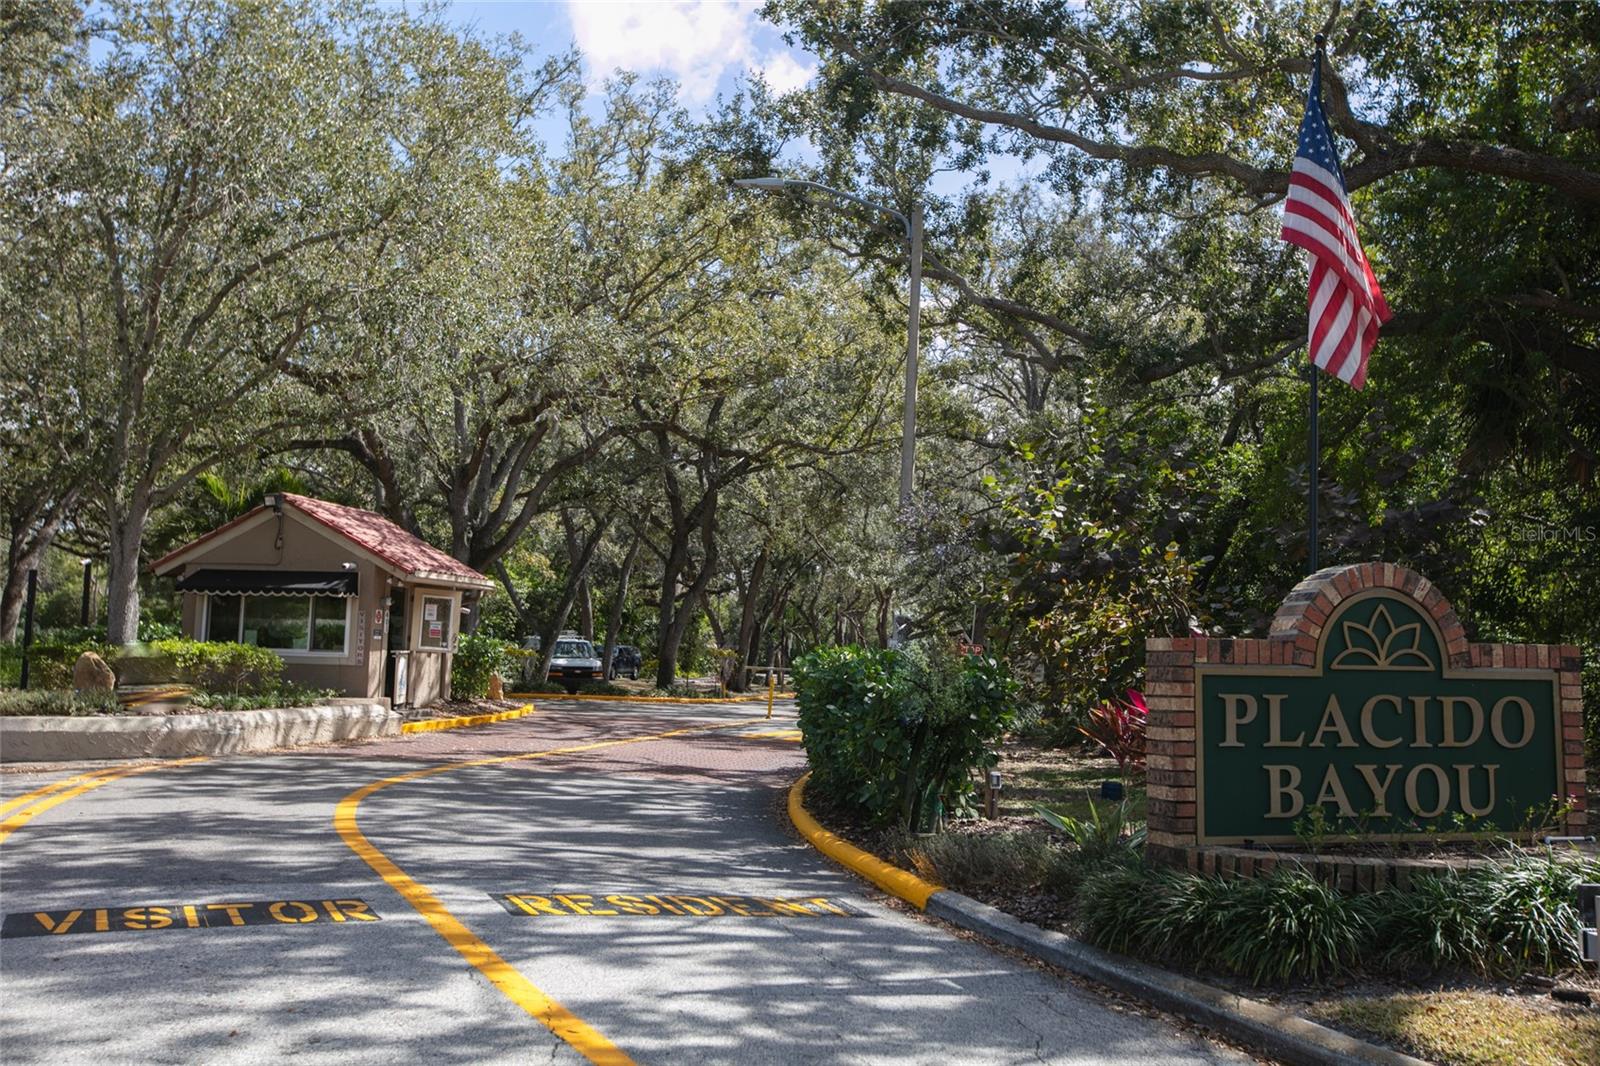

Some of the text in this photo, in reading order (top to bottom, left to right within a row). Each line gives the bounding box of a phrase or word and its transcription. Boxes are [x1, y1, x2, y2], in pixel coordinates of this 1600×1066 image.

[1218, 693, 1537, 750] PLACIDO
[1262, 763, 1500, 819] BAYOU
[34, 900, 380, 934] VISITOR
[503, 894, 850, 917] RESIDENT
